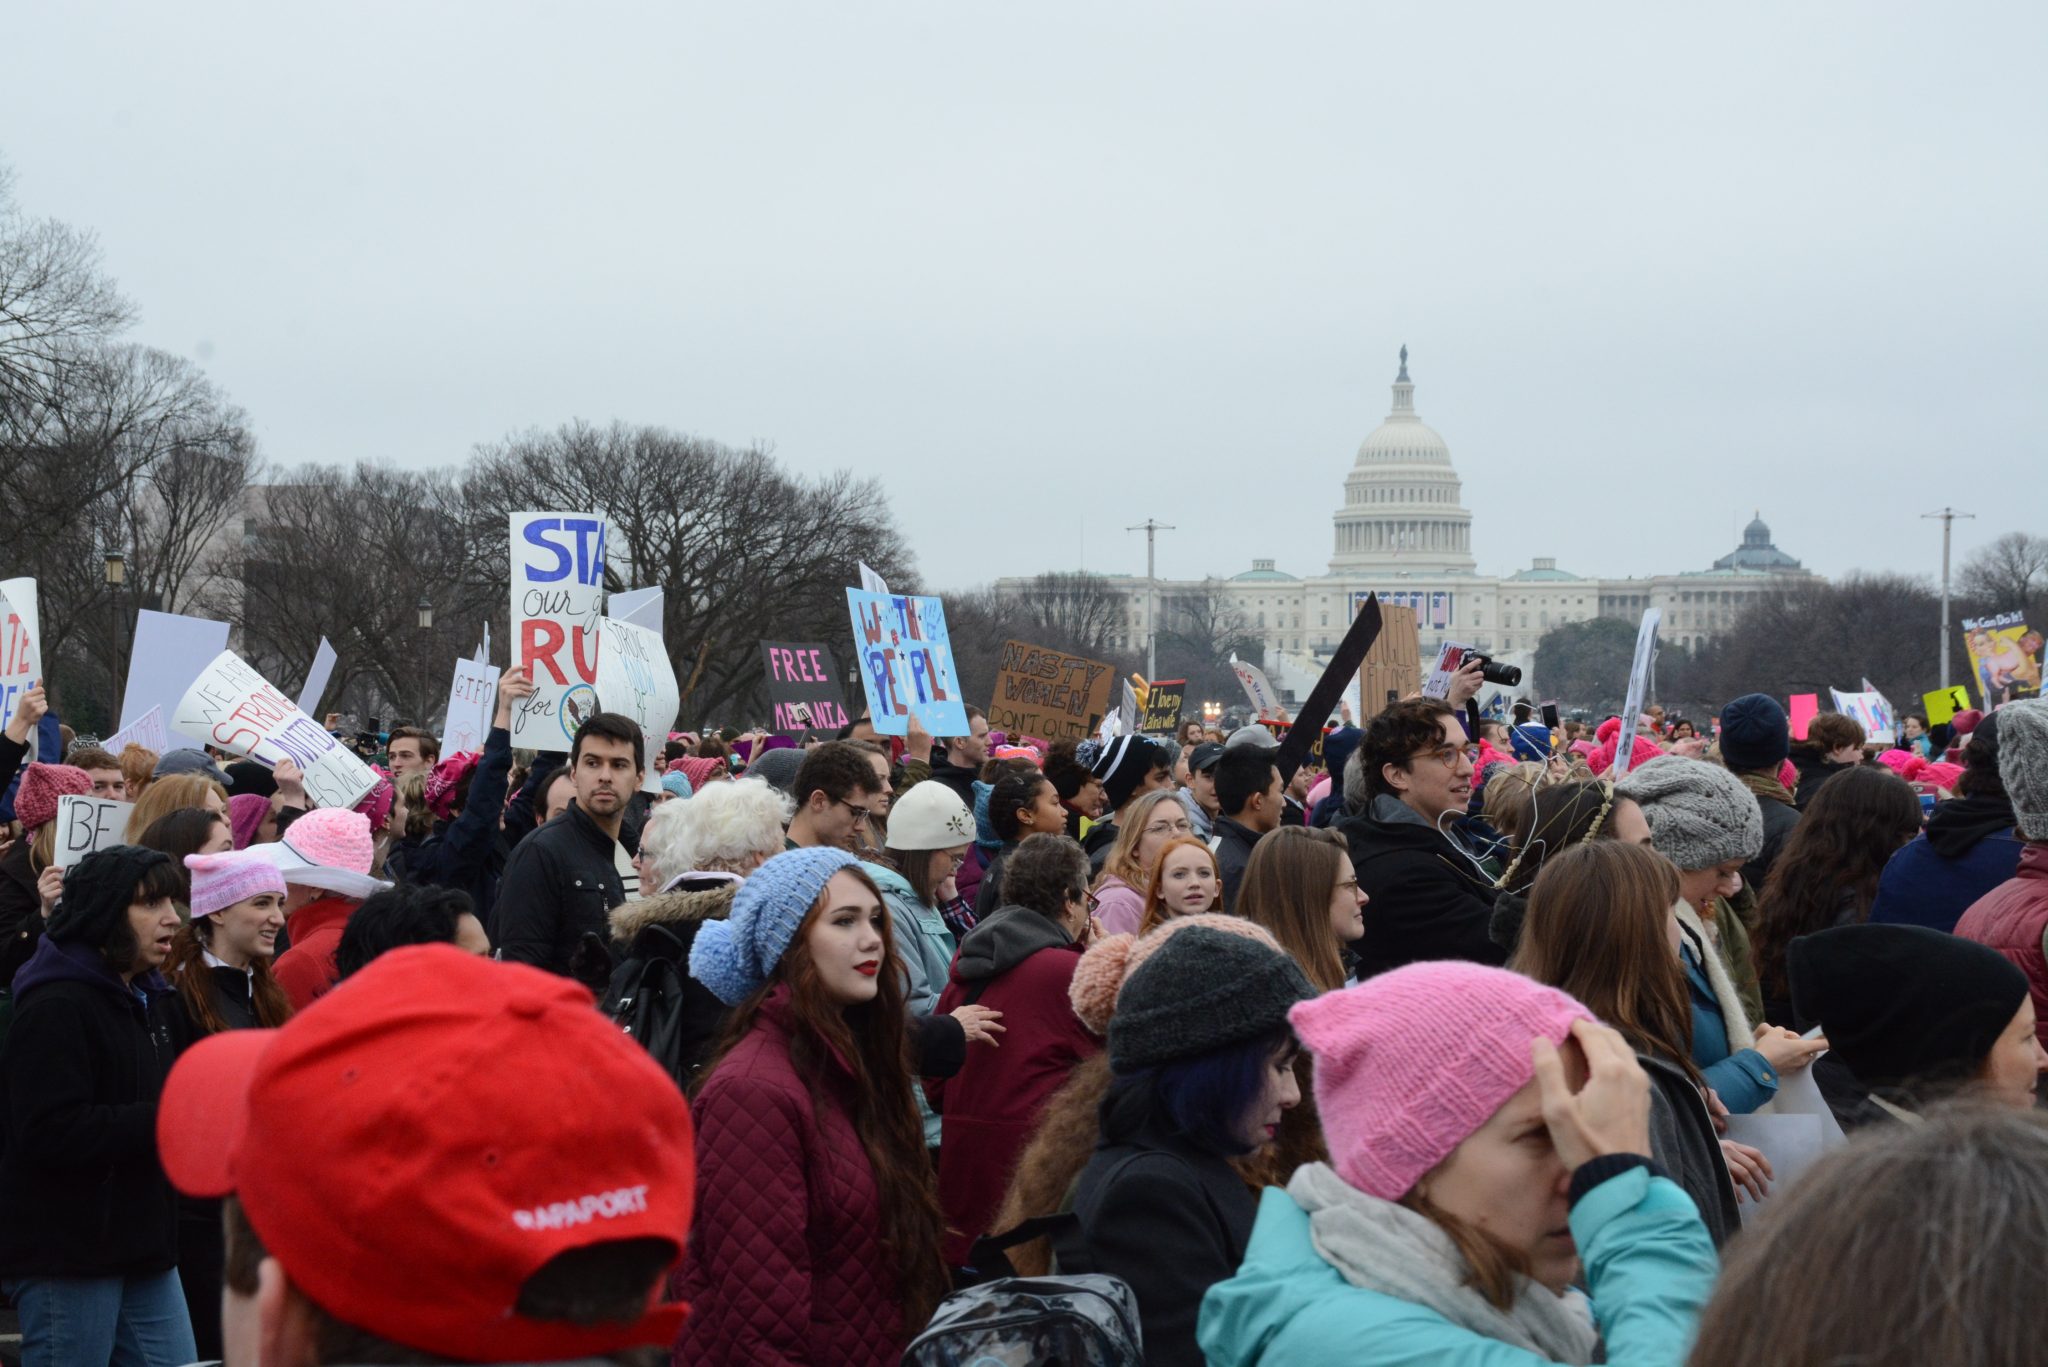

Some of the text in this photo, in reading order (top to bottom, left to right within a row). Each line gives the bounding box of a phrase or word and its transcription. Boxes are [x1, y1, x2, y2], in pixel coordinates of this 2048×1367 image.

[523, 589, 585, 617] our
[1978, 616, 1996, 628] Can
[1995, 613, 2011, 626] Do
[769, 647, 828, 682] FREE
[868, 644, 960, 717] PEOPLE
[1000, 642, 1106, 692] NASTY
[180, 658, 261, 724] WE ARE
[514, 687, 556, 735] for
[1005, 674, 1090, 718] WOMEN
[1149, 687, 1182, 713] I love my
[212, 684, 297, 755] STRONG
[988, 705, 1041, 734] DON'T
[305, 774, 344, 808] AS
[512, 1185, 649, 1231] RAPAPORT
